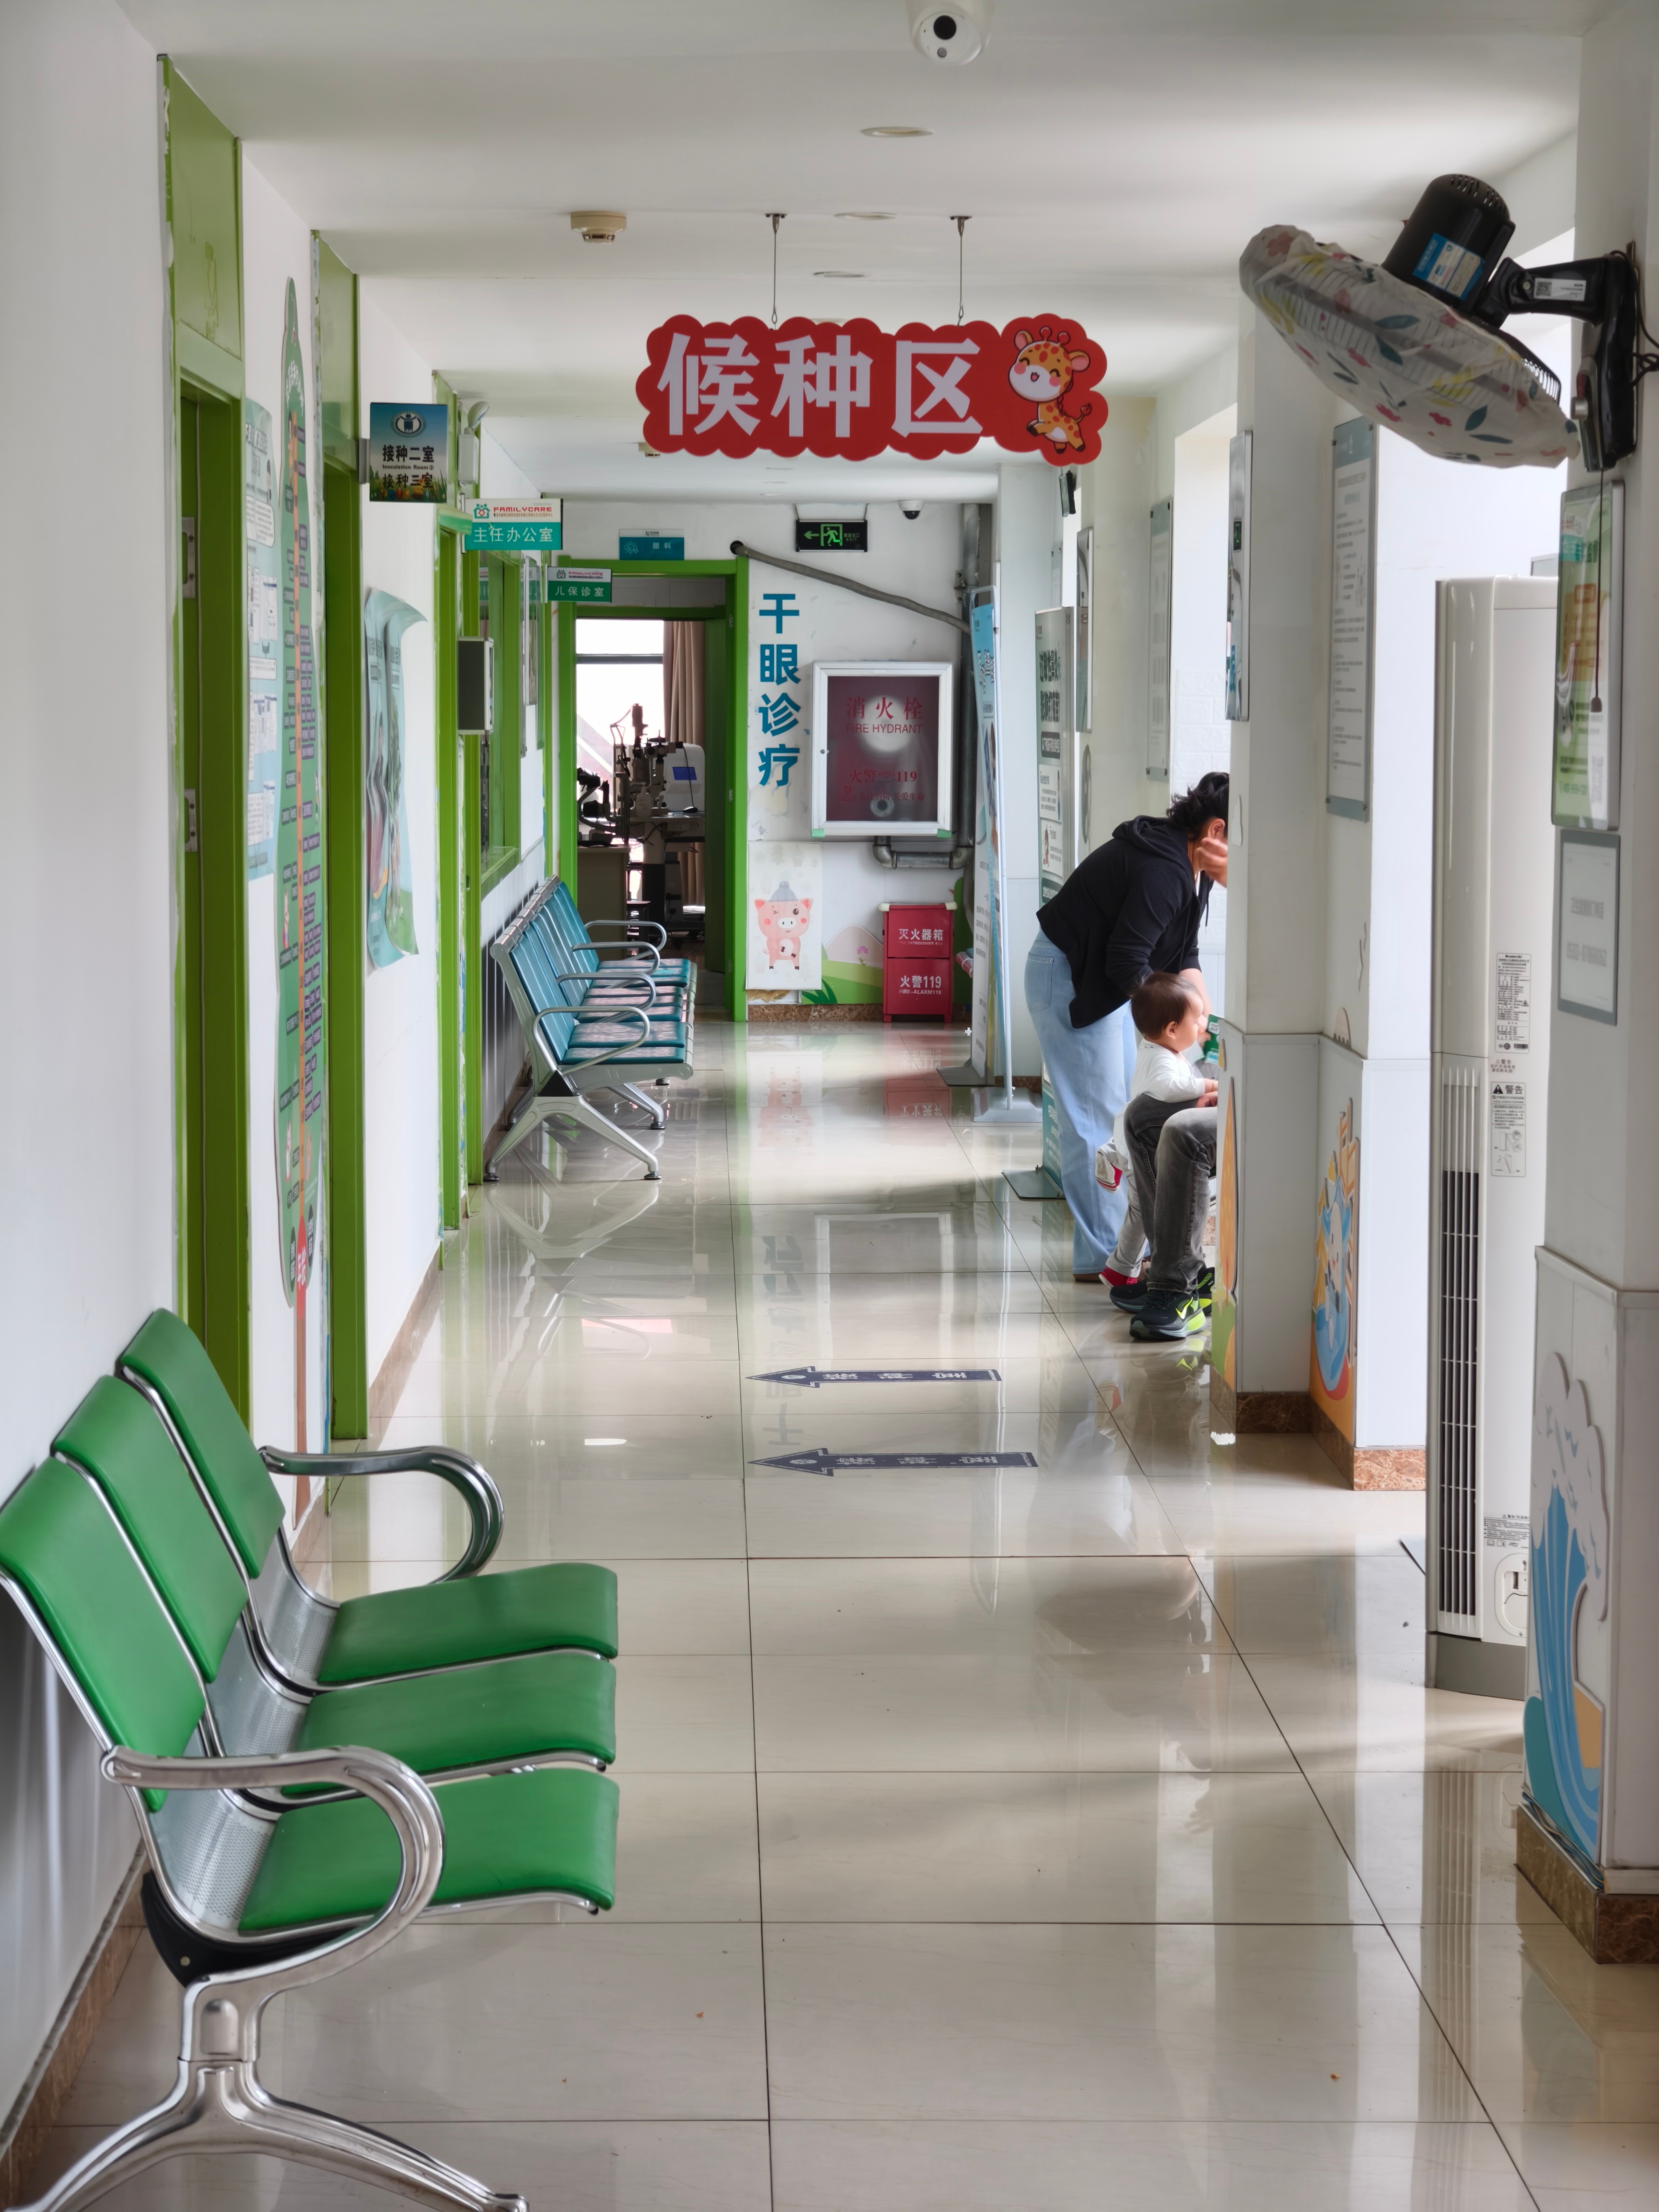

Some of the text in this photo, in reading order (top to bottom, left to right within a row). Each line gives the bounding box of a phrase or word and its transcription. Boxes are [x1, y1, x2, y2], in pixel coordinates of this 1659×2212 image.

[657, 332, 983, 437] 候种区
[382, 444, 434, 463] 接种二室
[383, 472, 434, 488] 接种三室
[474, 527, 553, 542] 主任办公室
[555, 586, 604, 597] 儿保诊室
[759, 594, 801, 787] 干眼诊疗
[846, 697, 923, 720] 消火栓
[846, 724, 923, 733] FIRE HYDRANT
[849, 769, 917, 783] 火警 119
[899, 929, 943, 941] 灭火器箱
[1505, 1085, 1523, 1094] 警告
